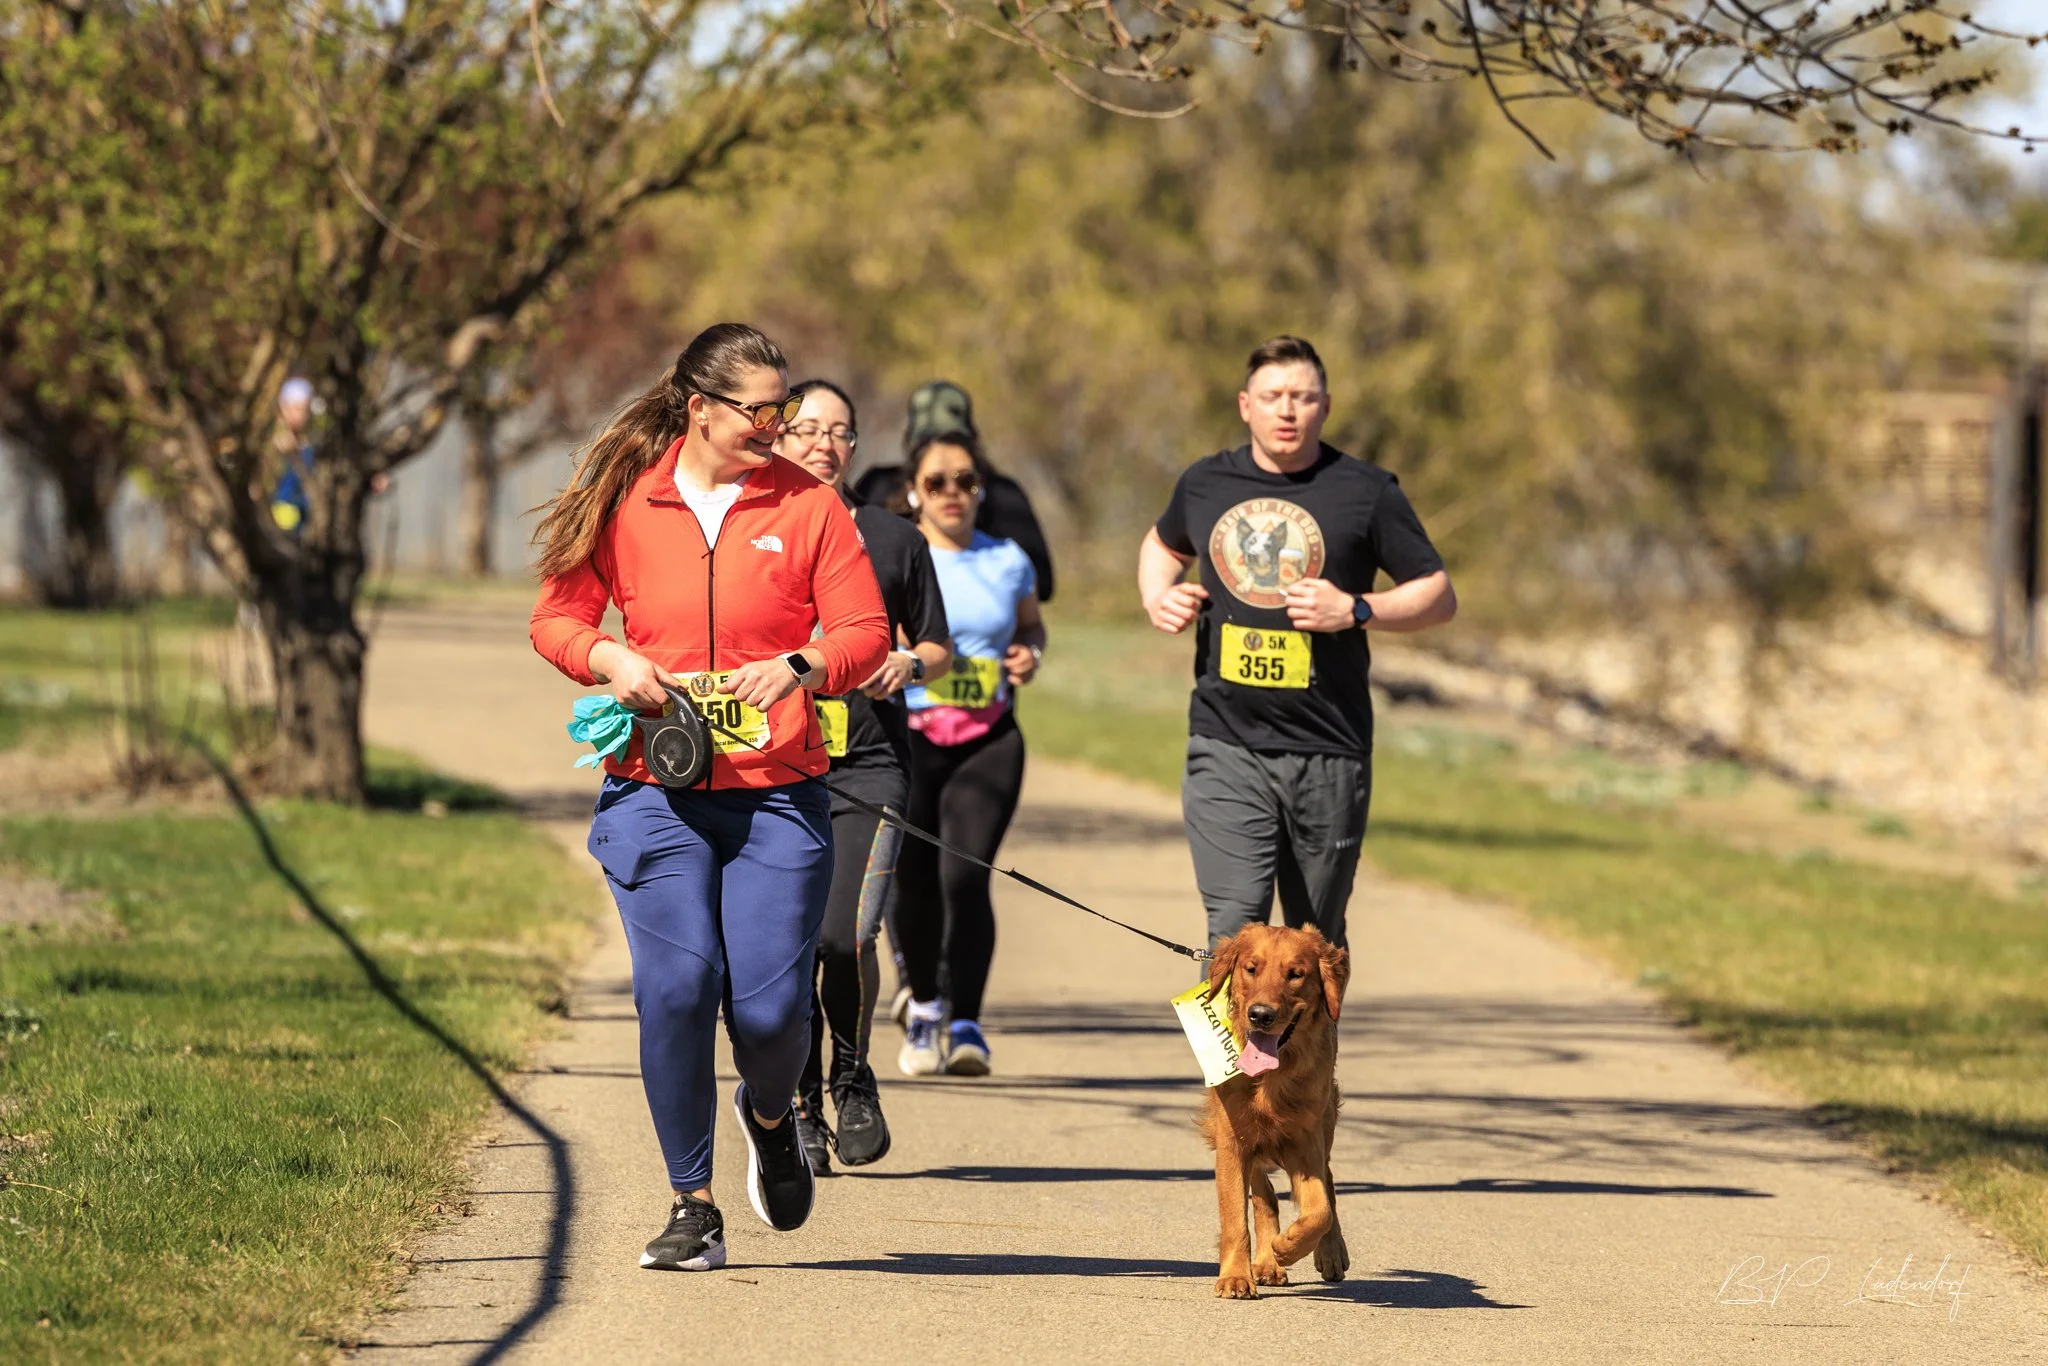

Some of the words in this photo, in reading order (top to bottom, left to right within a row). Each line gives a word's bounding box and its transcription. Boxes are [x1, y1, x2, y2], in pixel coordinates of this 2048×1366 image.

[1251, 502, 1269, 513] OF
[1276, 503, 1300, 520] THE
[1299, 517, 1320, 544] DOG
[1268, 635, 1286, 650] 5K
[1239, 654, 1285, 681] 355
[952, 679, 983, 702] 173
